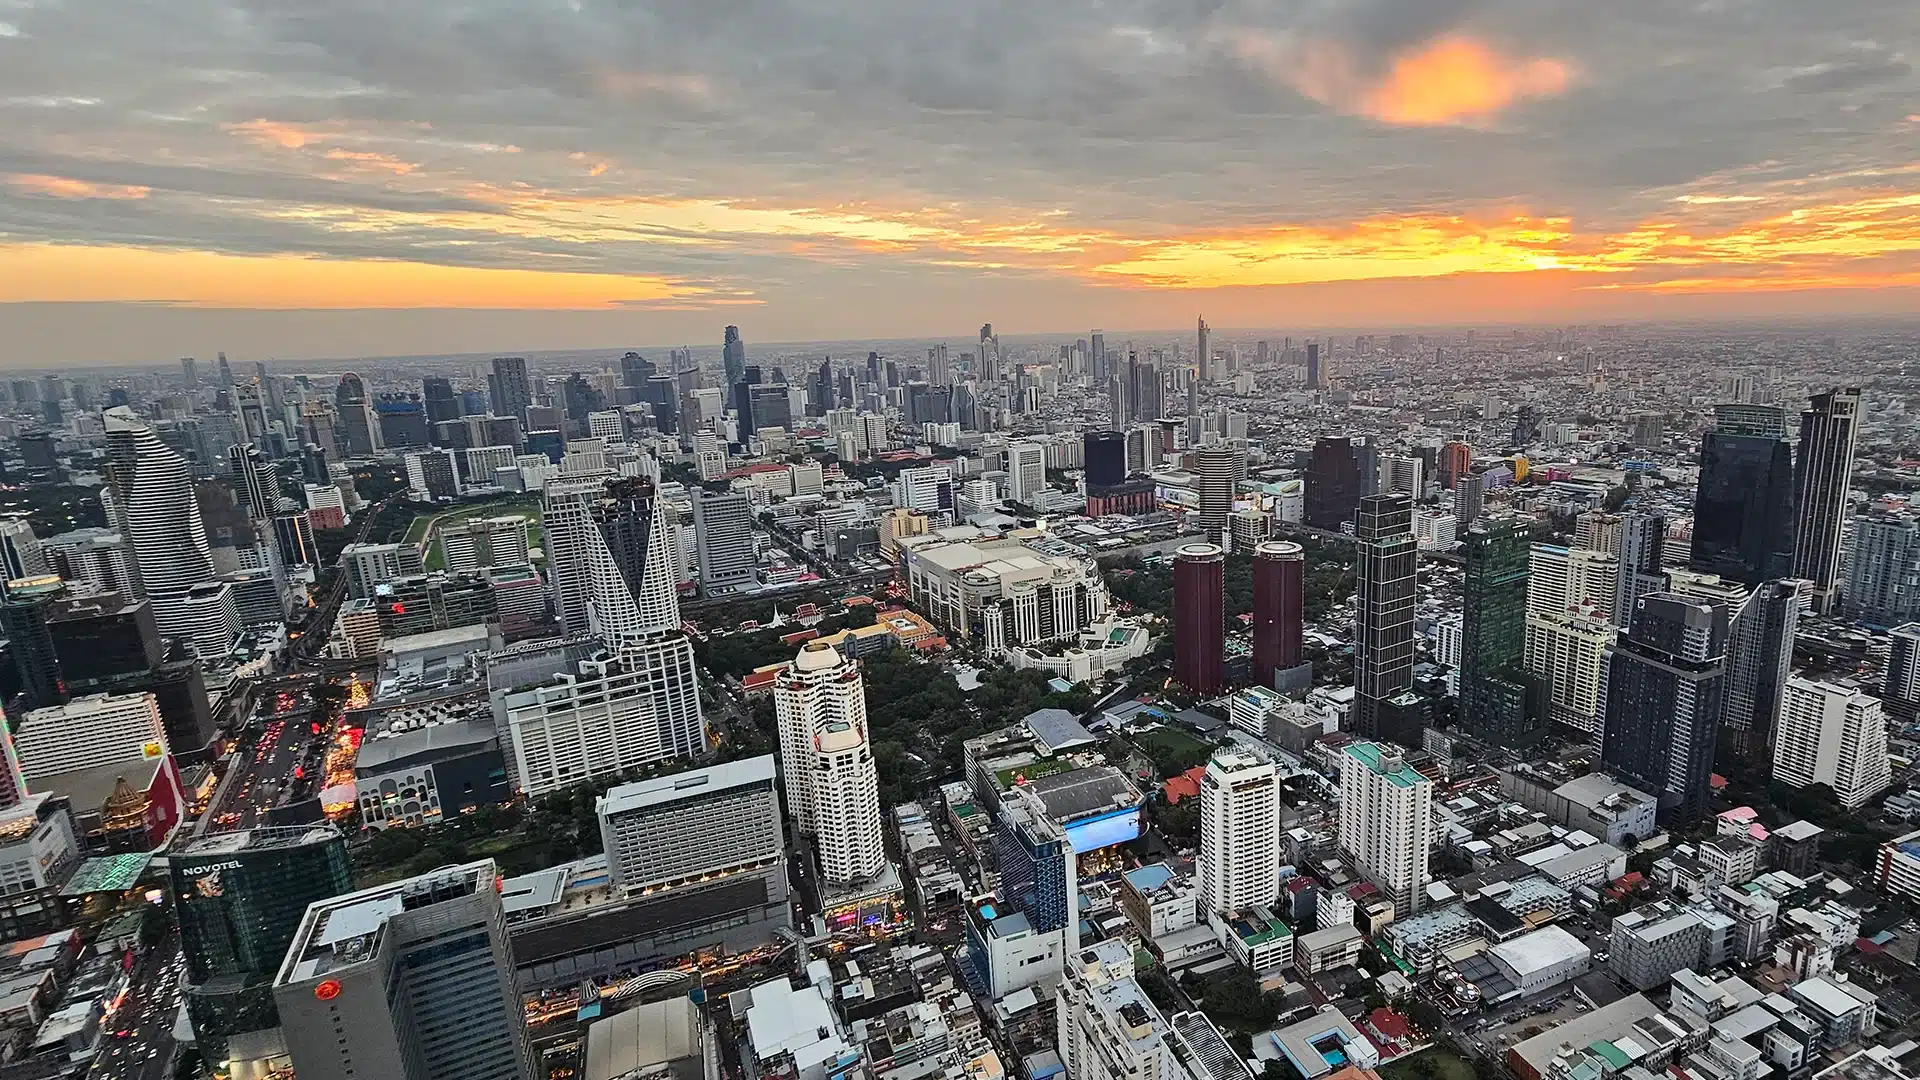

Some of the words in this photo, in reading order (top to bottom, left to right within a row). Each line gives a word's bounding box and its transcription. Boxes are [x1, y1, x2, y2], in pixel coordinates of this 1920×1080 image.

[183, 860, 243, 876] NOVOTEL
[825, 897, 847, 906] GRAND
[849, 889, 878, 900] DIAMOND
[880, 883, 901, 892] PLAZA
